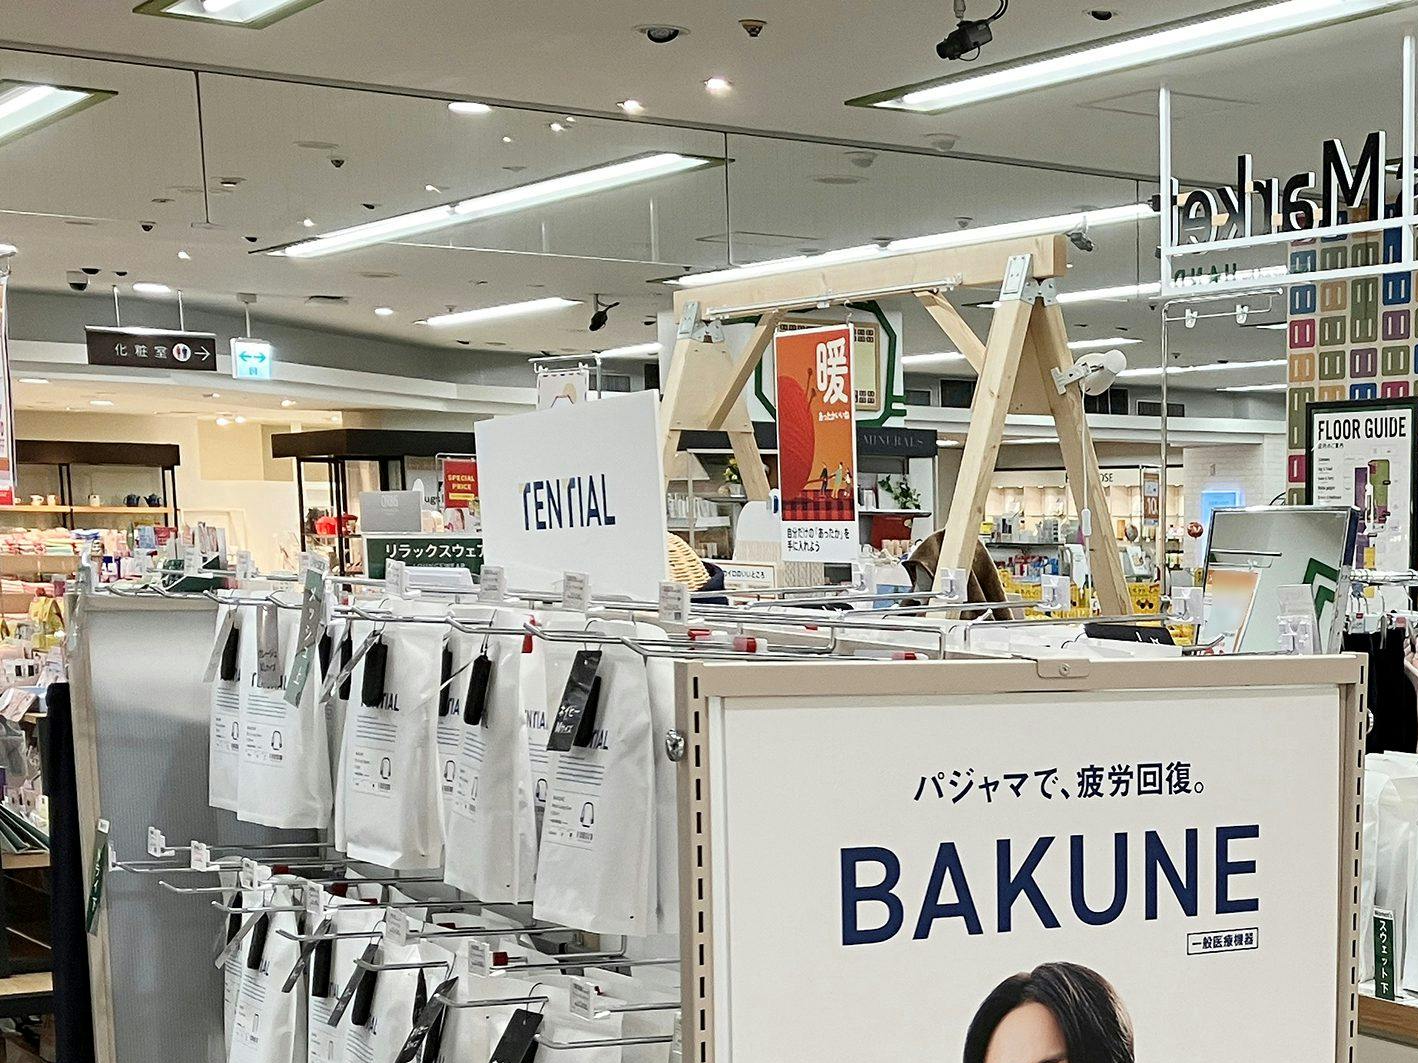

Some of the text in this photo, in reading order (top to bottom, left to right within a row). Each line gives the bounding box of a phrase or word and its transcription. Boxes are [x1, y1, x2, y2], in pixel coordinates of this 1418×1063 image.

[114, 342, 168, 360] 化粧室
[816, 336, 849, 405] 暖
[1318, 416, 1407, 442] FLOOR GUIDE
[448, 474, 475, 483] SPECIAL
[452, 483, 472, 491] PRICE
[518, 473, 616, 531] TENTIAL
[787, 527, 850, 540] 自分だけの「あったか」を
[787, 540, 820, 552] 手に入れよう
[913, 760, 1206, 803] パジャマで、疲労回復。
[839, 824, 1260, 946] BAKUNE
[1190, 931, 1256, 953] 一般医療機器
